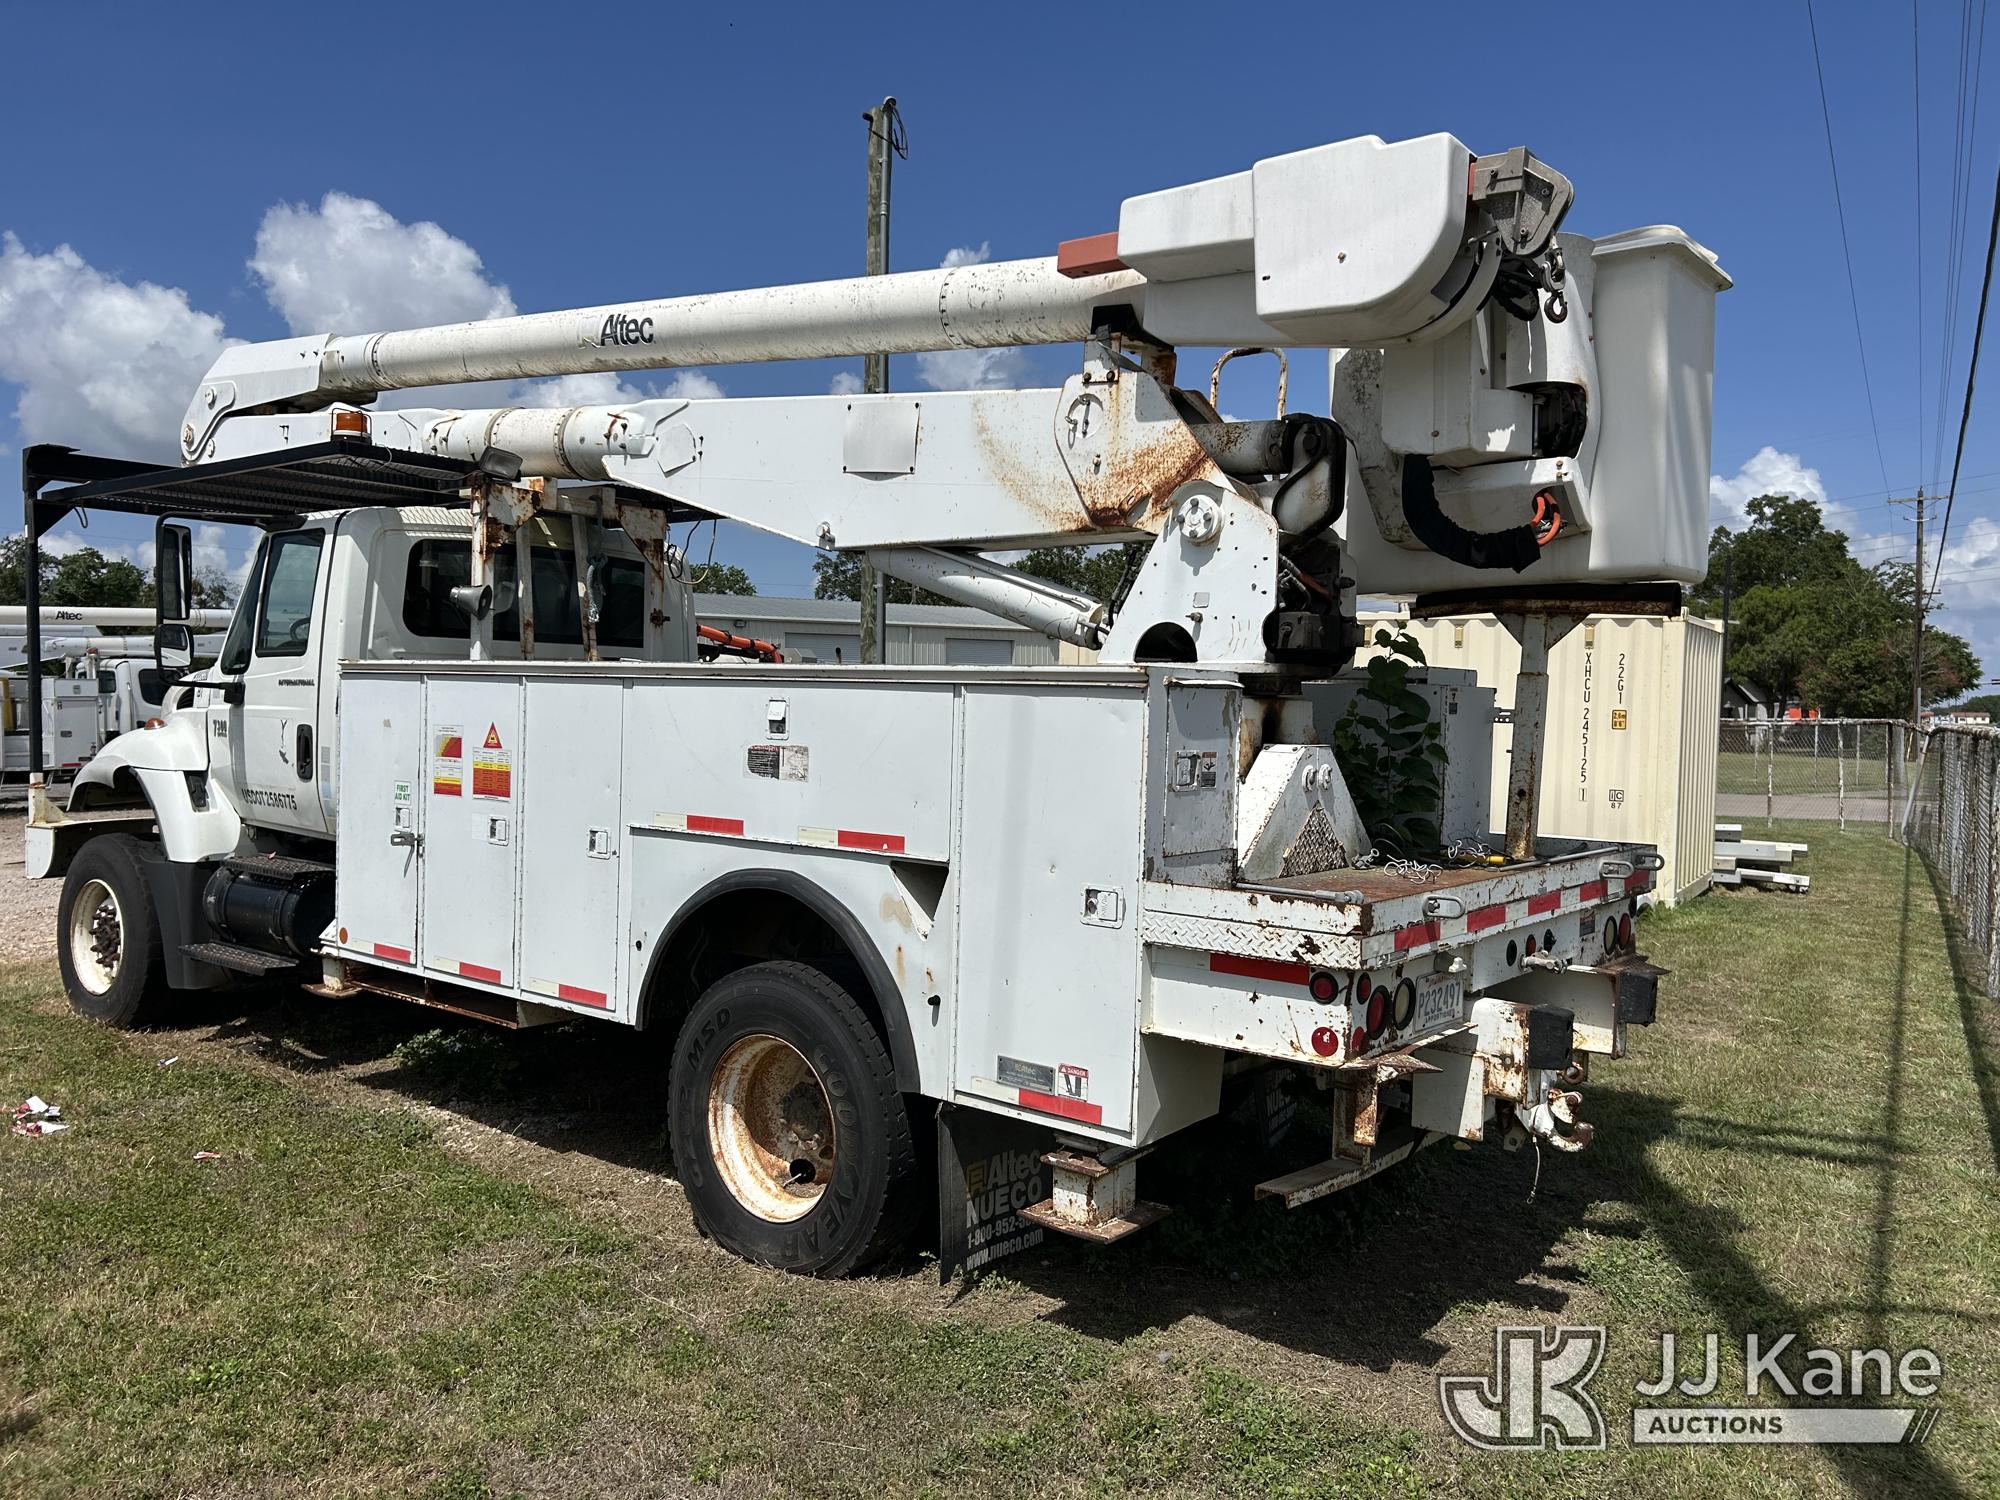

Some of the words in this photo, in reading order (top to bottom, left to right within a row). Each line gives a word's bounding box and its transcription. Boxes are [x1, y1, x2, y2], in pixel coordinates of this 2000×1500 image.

[600, 313, 654, 346] Altec
[55, 610, 83, 621] Altec
[1583, 652, 1592, 703] XHCU
[1617, 653, 1625, 705] 22G1
[1580, 707, 1590, 783] 245125
[394, 792, 403, 801] AID
[402, 793, 411, 801] KIT
[396, 784, 409, 793] FIRST
[1417, 982, 1461, 1019] P232497
[687, 1007, 731, 1073] MSD
[1067, 1067, 1086, 1077] DANGER
[987, 1149, 1041, 1190] Altec
[966, 1175, 1042, 1229] NUECO
[966, 1228, 1044, 1271] www.nueco.com
